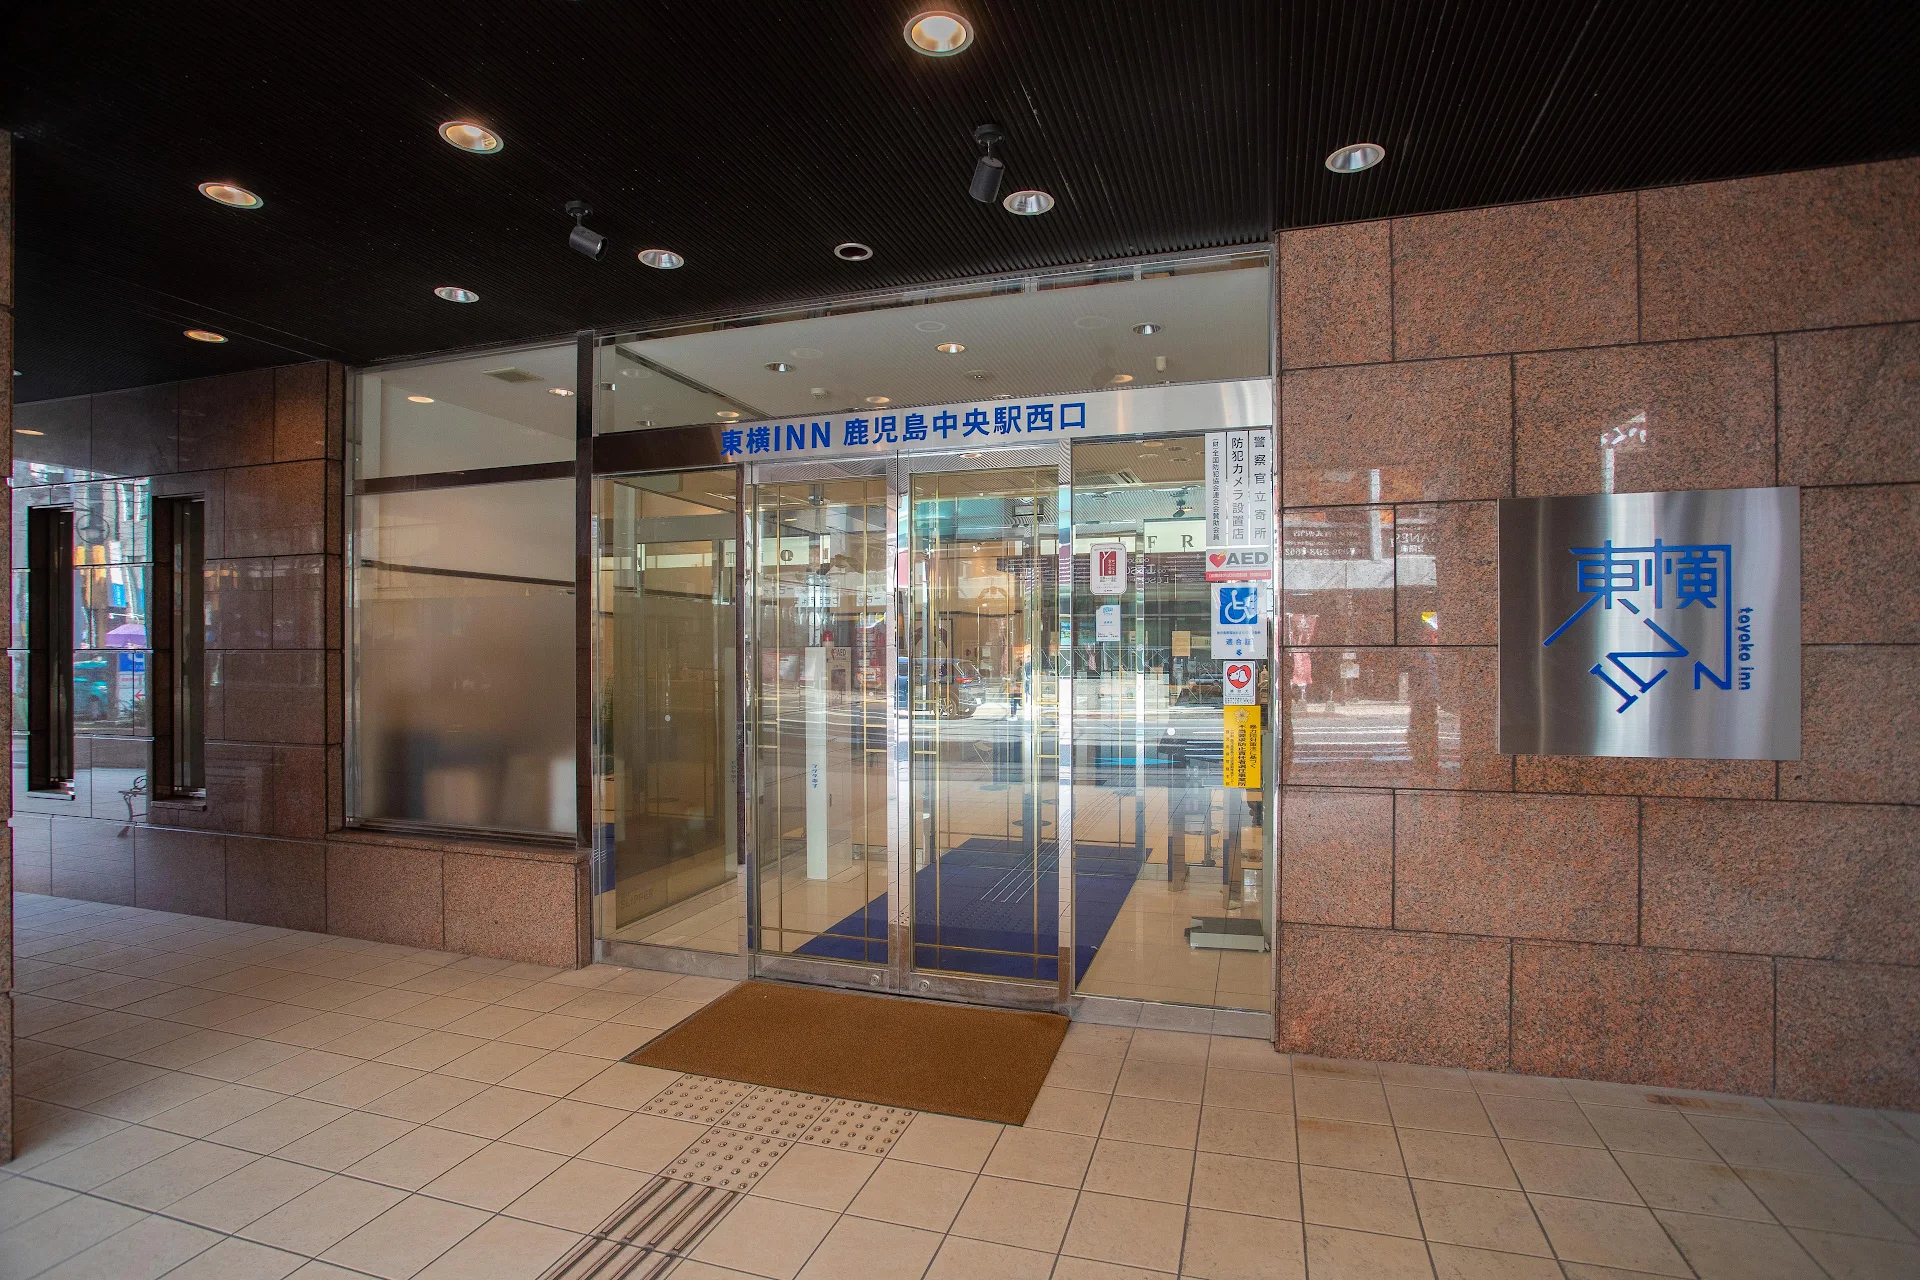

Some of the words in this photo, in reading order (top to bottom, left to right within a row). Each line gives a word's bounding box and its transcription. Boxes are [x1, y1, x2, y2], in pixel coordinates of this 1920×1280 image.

[843, 402, 1087, 447] 鹿児島中央駅西口
[1231, 437, 1245, 540] 防犯カメラ設置店
[1253, 436, 1267, 539] 警察官立寄所
[1225, 551, 1269, 566] AED
[1737, 607, 1754, 662] toyoko
[1738, 666, 1754, 691] inn
